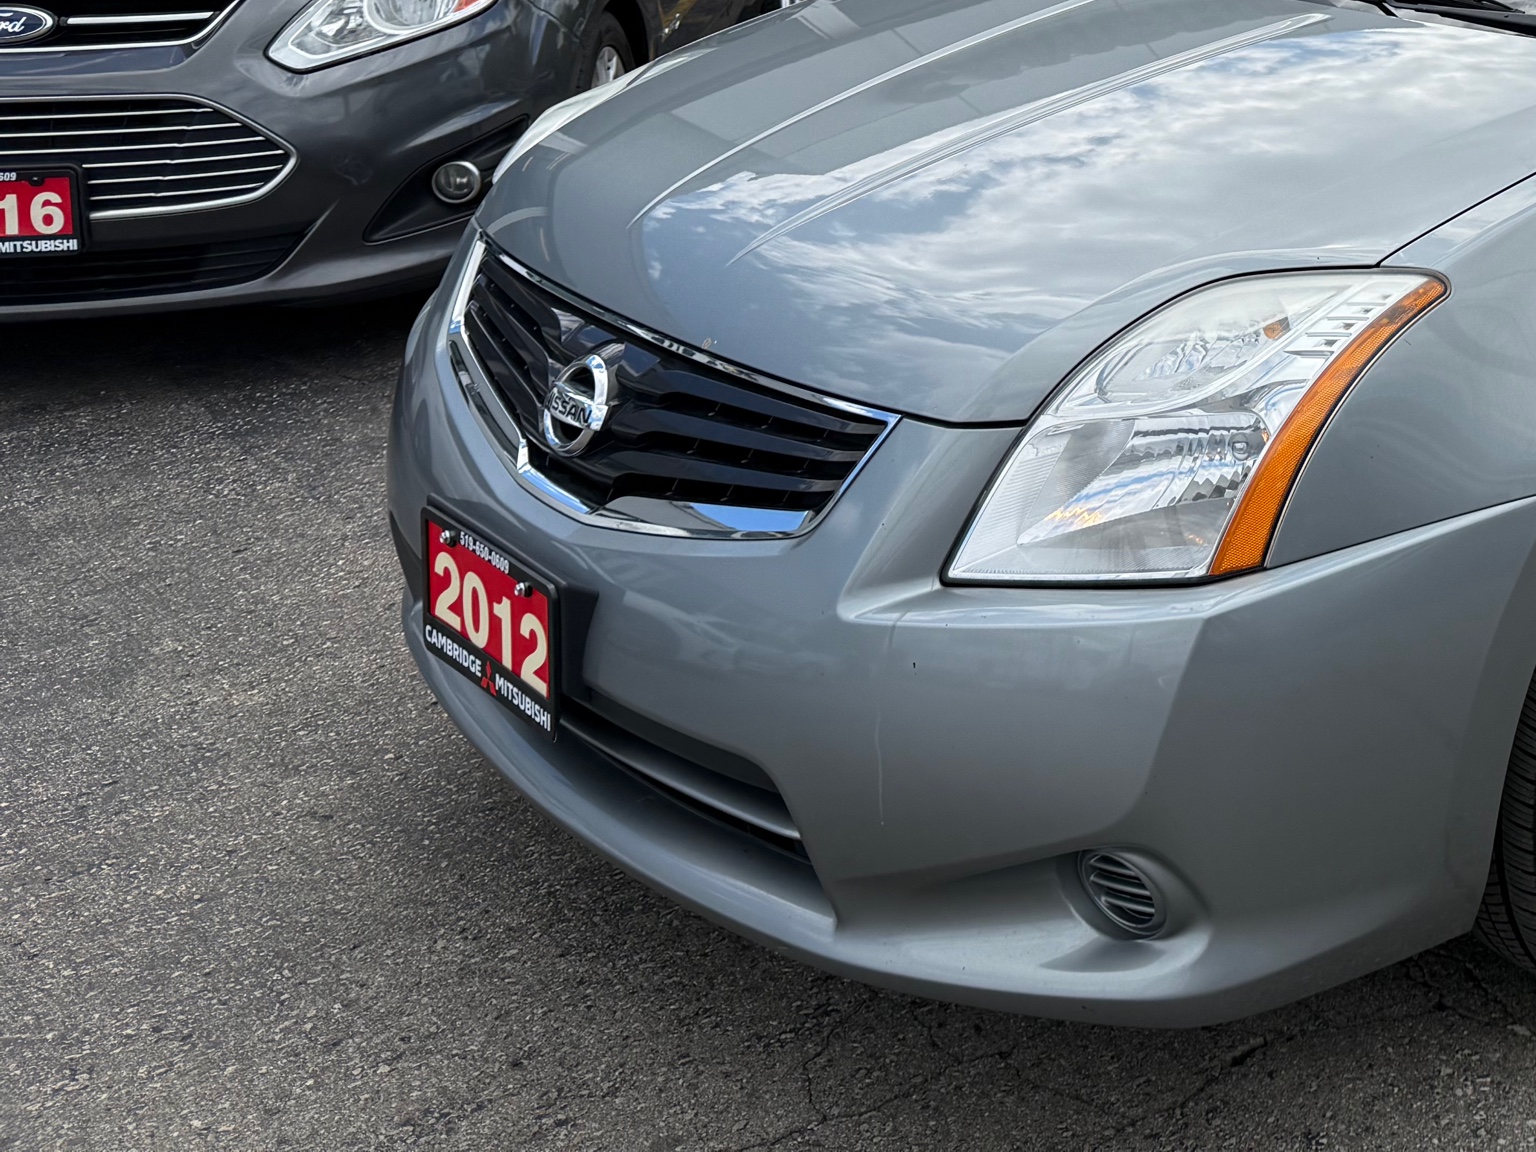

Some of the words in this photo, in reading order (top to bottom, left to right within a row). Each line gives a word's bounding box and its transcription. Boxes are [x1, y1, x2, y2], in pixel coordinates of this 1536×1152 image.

[0, 239, 78, 253] MITSUBISHI
[459, 531, 510, 575] 519-650-0609
[425, 624, 482, 678] CAMBRIDGE
[434, 551, 548, 698] 2012
[494, 673, 551, 732] MITSUBISHI
